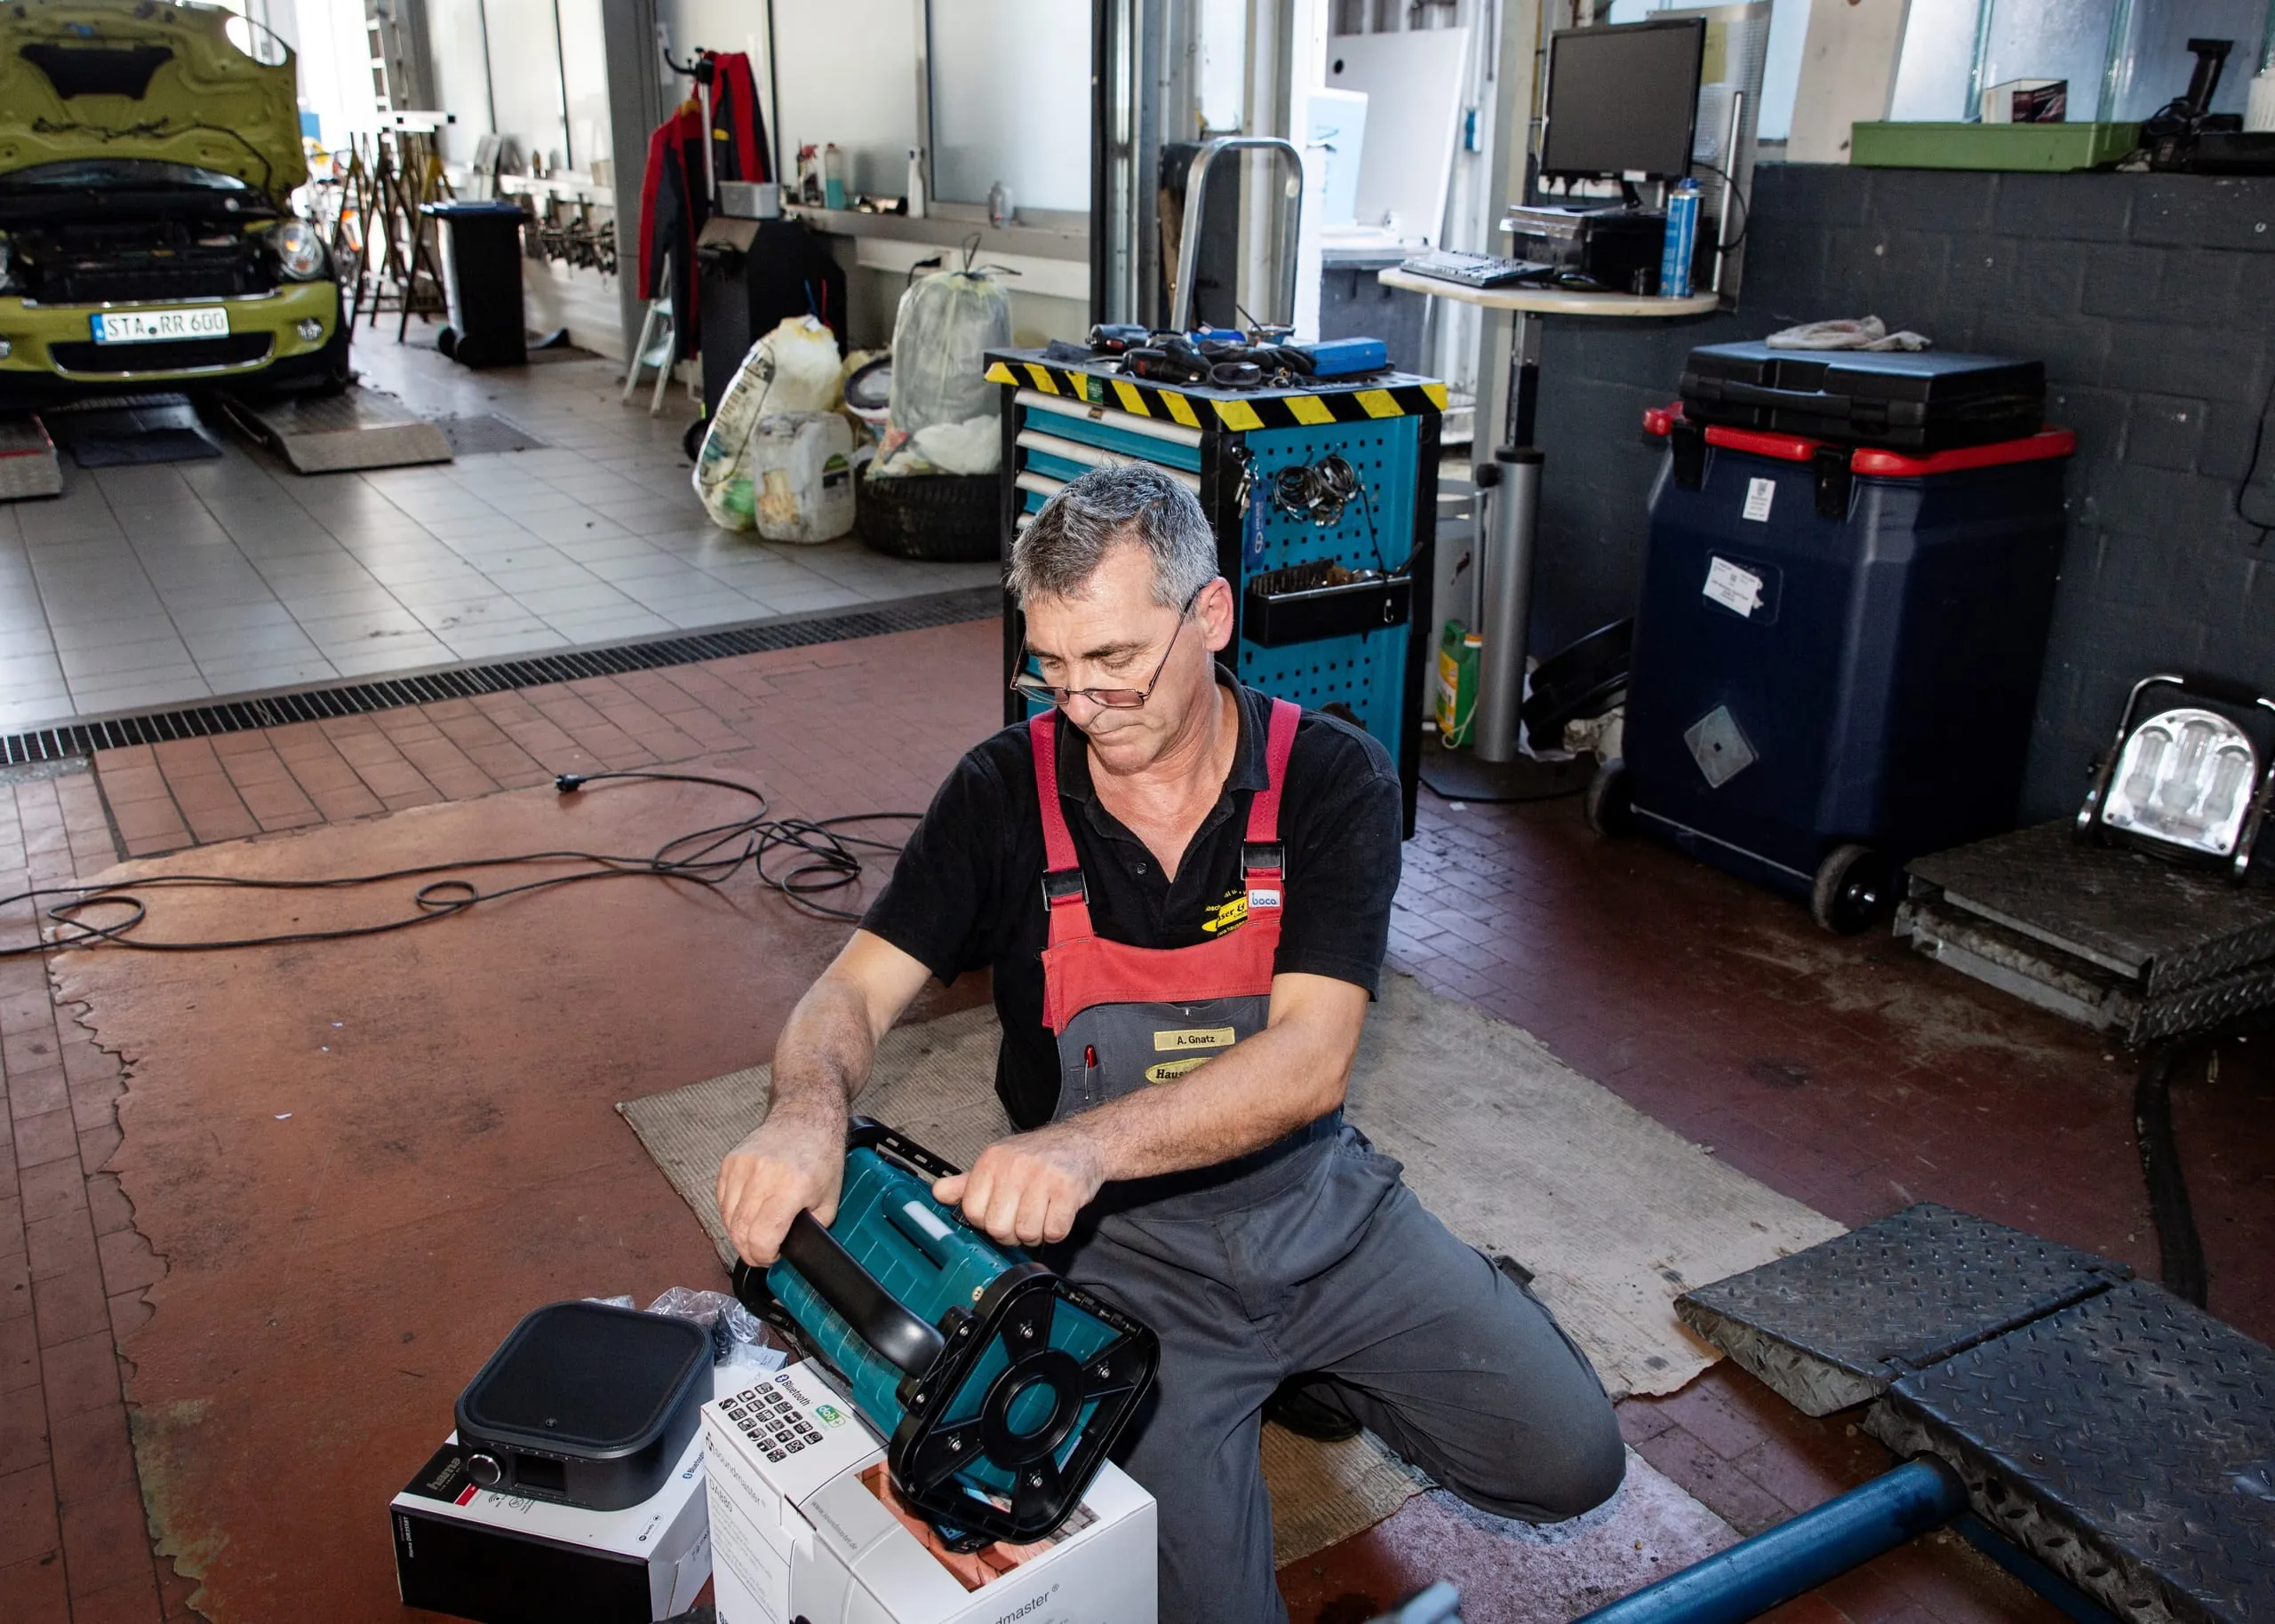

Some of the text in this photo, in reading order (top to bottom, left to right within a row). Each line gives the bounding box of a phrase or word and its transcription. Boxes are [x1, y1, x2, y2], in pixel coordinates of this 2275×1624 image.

[108, 312, 225, 337] STA RR 600
[1177, 1035, 1216, 1046] A. Gnatz
[782, 1380, 810, 1406] Bluetooth
[427, 1457, 461, 1491] hama
